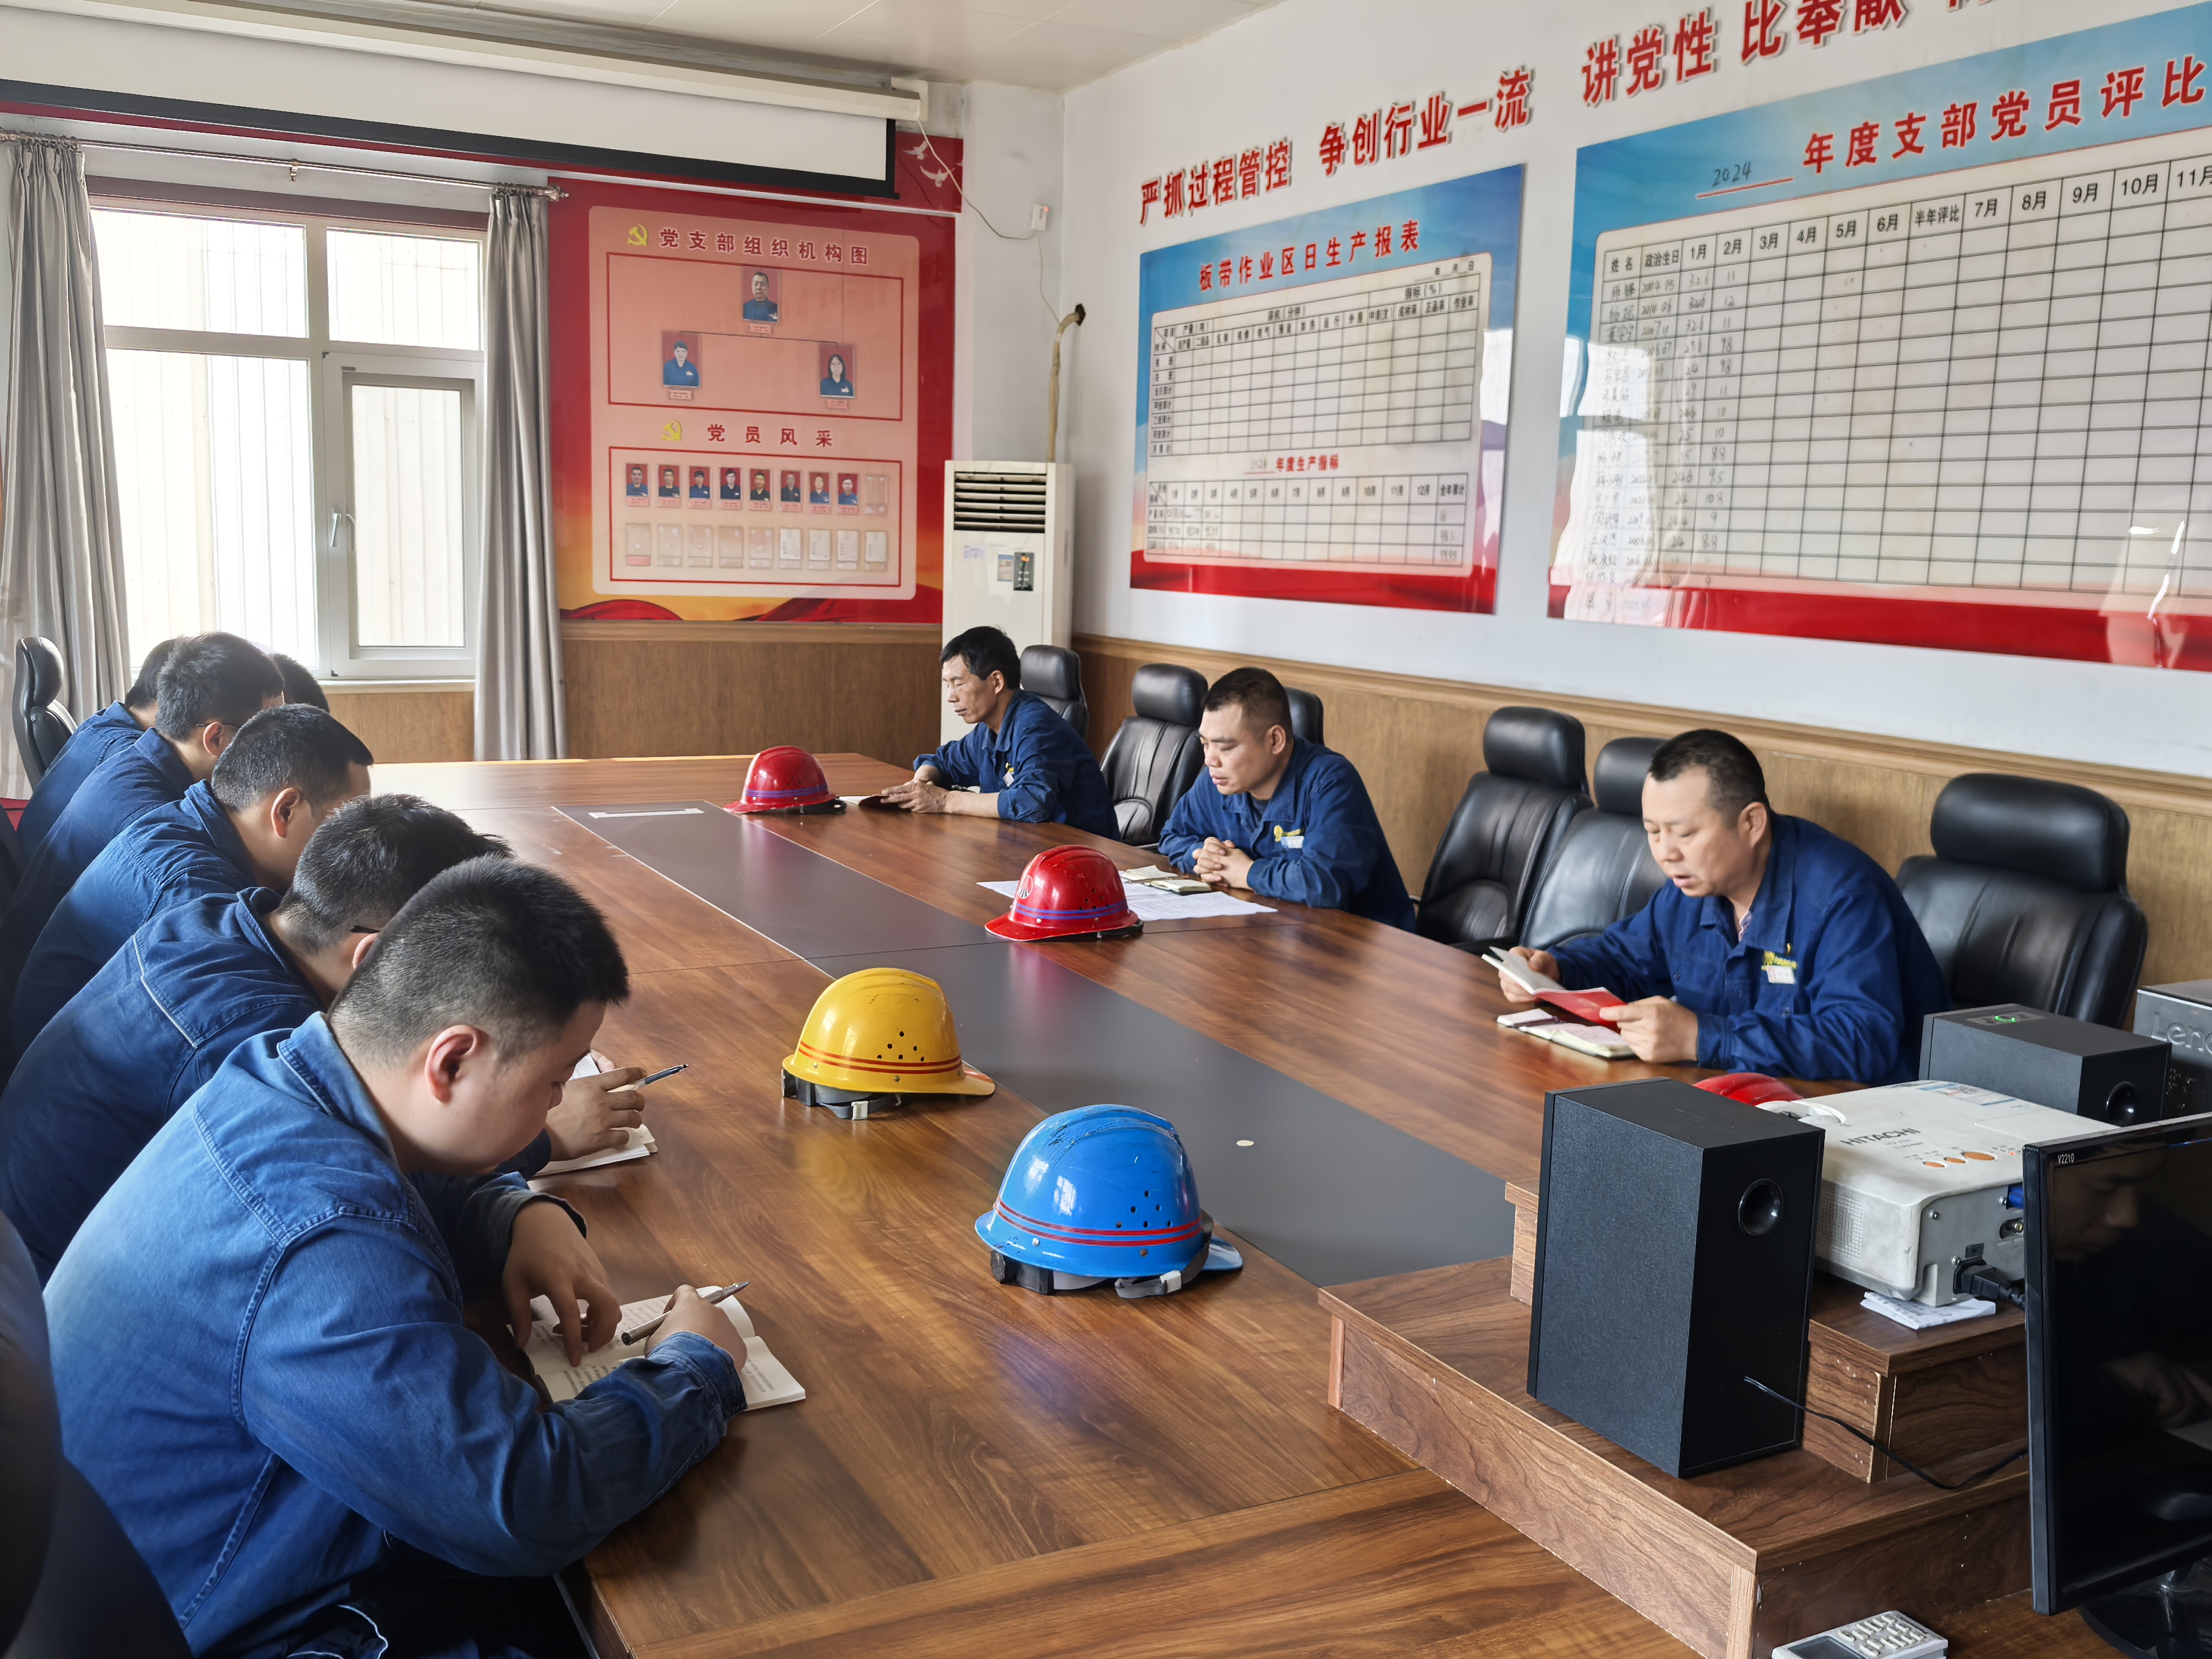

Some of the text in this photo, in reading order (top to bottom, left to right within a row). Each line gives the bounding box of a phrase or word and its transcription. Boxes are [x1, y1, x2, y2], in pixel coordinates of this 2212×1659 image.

[1581, 11, 1714, 104] 讲党性
[1140, 67, 1532, 225] 严抓过程管控 争创行业一流
[1802, 55, 2206, 174] 年度支部党员评比
[1712, 161, 1752, 187] 2024
[659, 227, 868, 265] 党支部组织机构图
[1690, 244, 1707, 260] 1月
[1723, 238, 1742, 255] 2月
[1759, 230, 1779, 252] 3月
[1796, 225, 1818, 245] 4月
[1835, 218, 1858, 239] 5月
[1877, 213, 1899, 233] 6月
[1913, 203, 1961, 228] 半年评比
[1974, 197, 1999, 219] 7月
[2021, 190, 2048, 211] 8月
[2072, 182, 2098, 203] 9月
[2121, 173, 2158, 195] 10月
[2177, 164, 2212, 187] 11月
[1199, 220, 1420, 292] 板带作业区日生产报表
[707, 423, 832, 448] 党员风采
[1839, 1127, 1921, 1145] HITACHI
